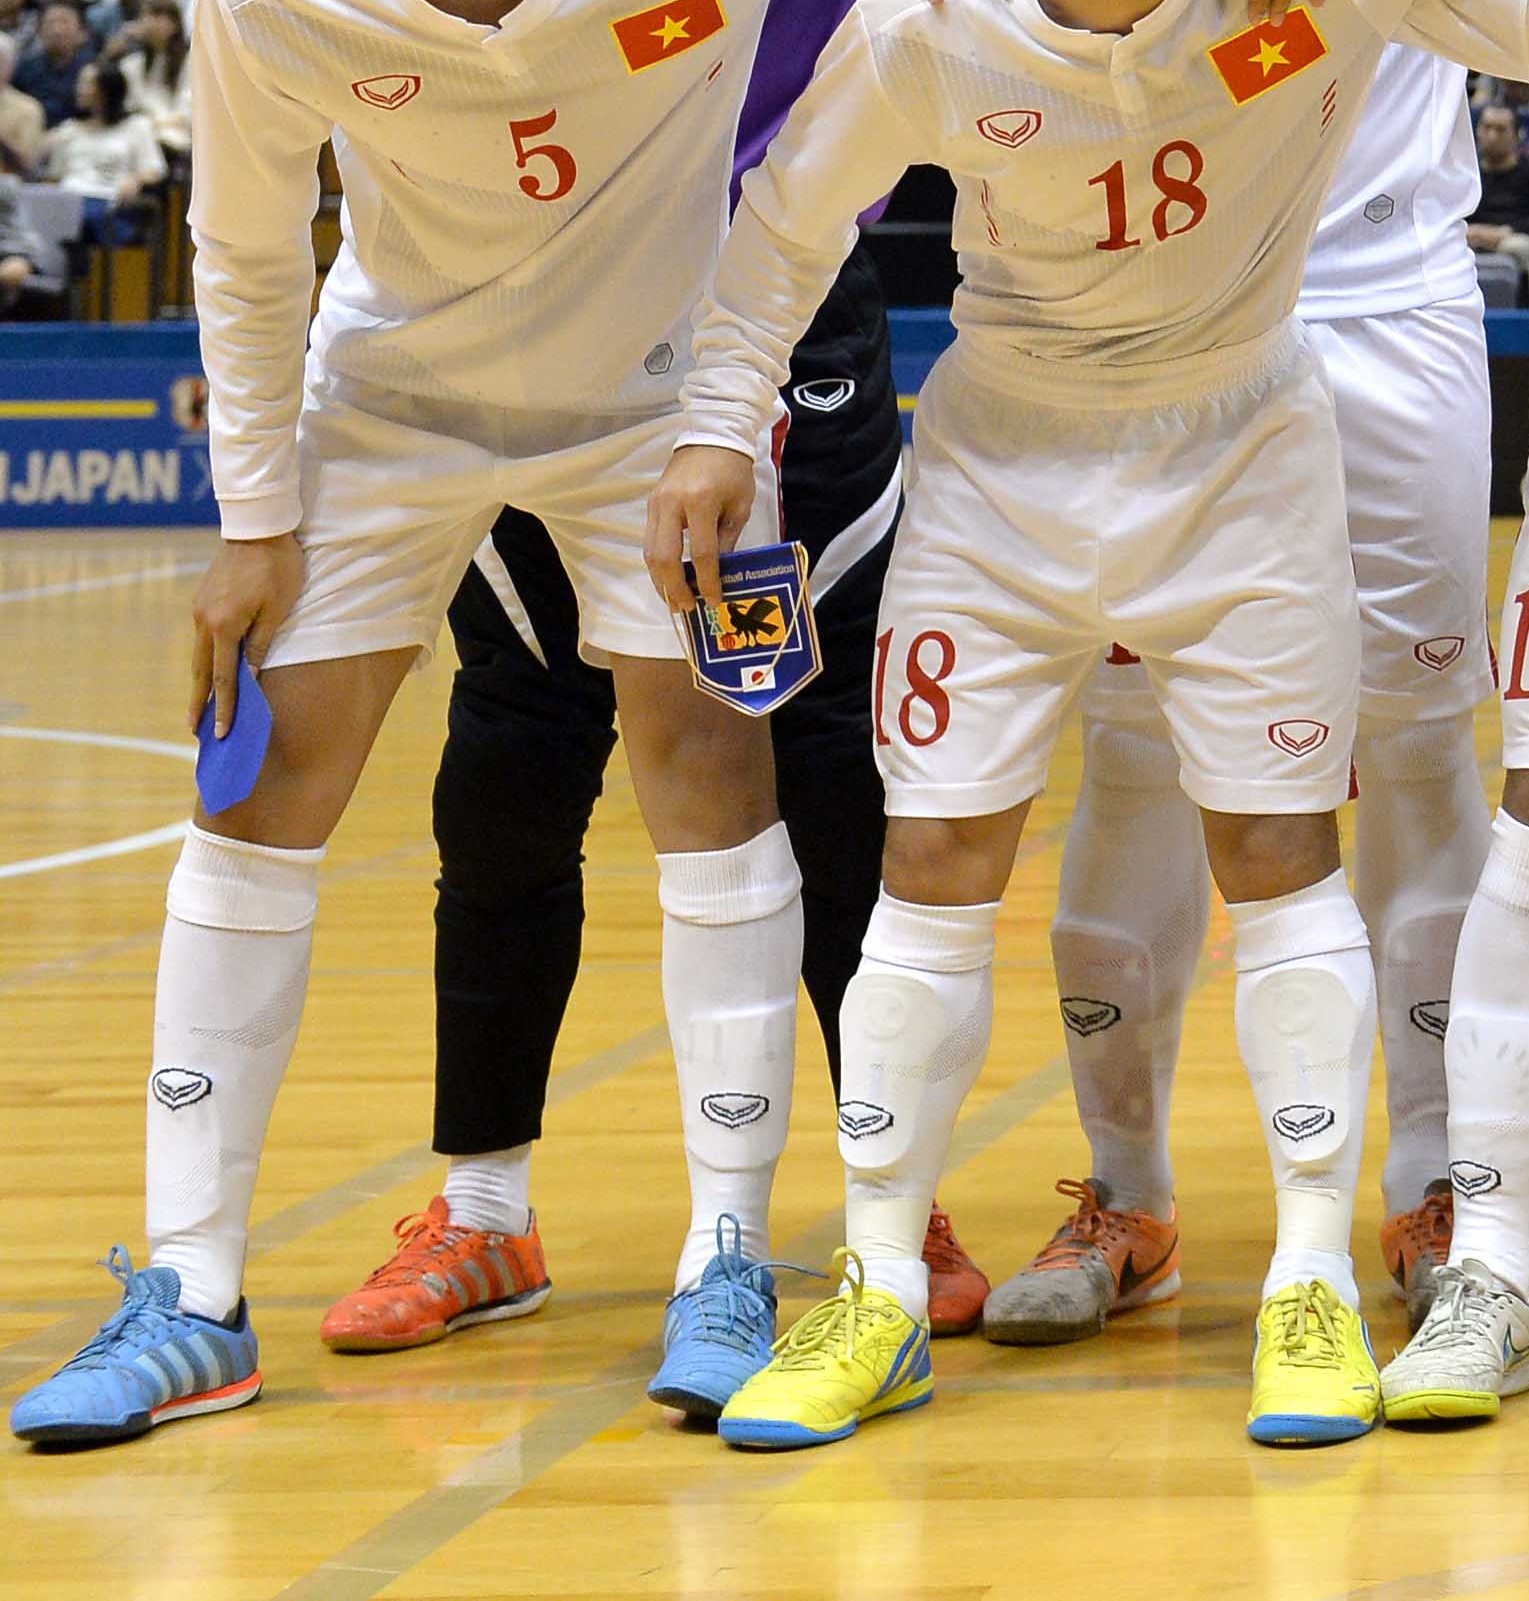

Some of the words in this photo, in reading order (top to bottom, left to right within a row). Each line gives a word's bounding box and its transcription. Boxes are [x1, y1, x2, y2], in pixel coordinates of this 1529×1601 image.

[509, 109, 577, 201] 5
[1088, 140, 1207, 251] 18
[12, 448, 182, 506] JAPAN
[875, 627, 957, 747] 18
